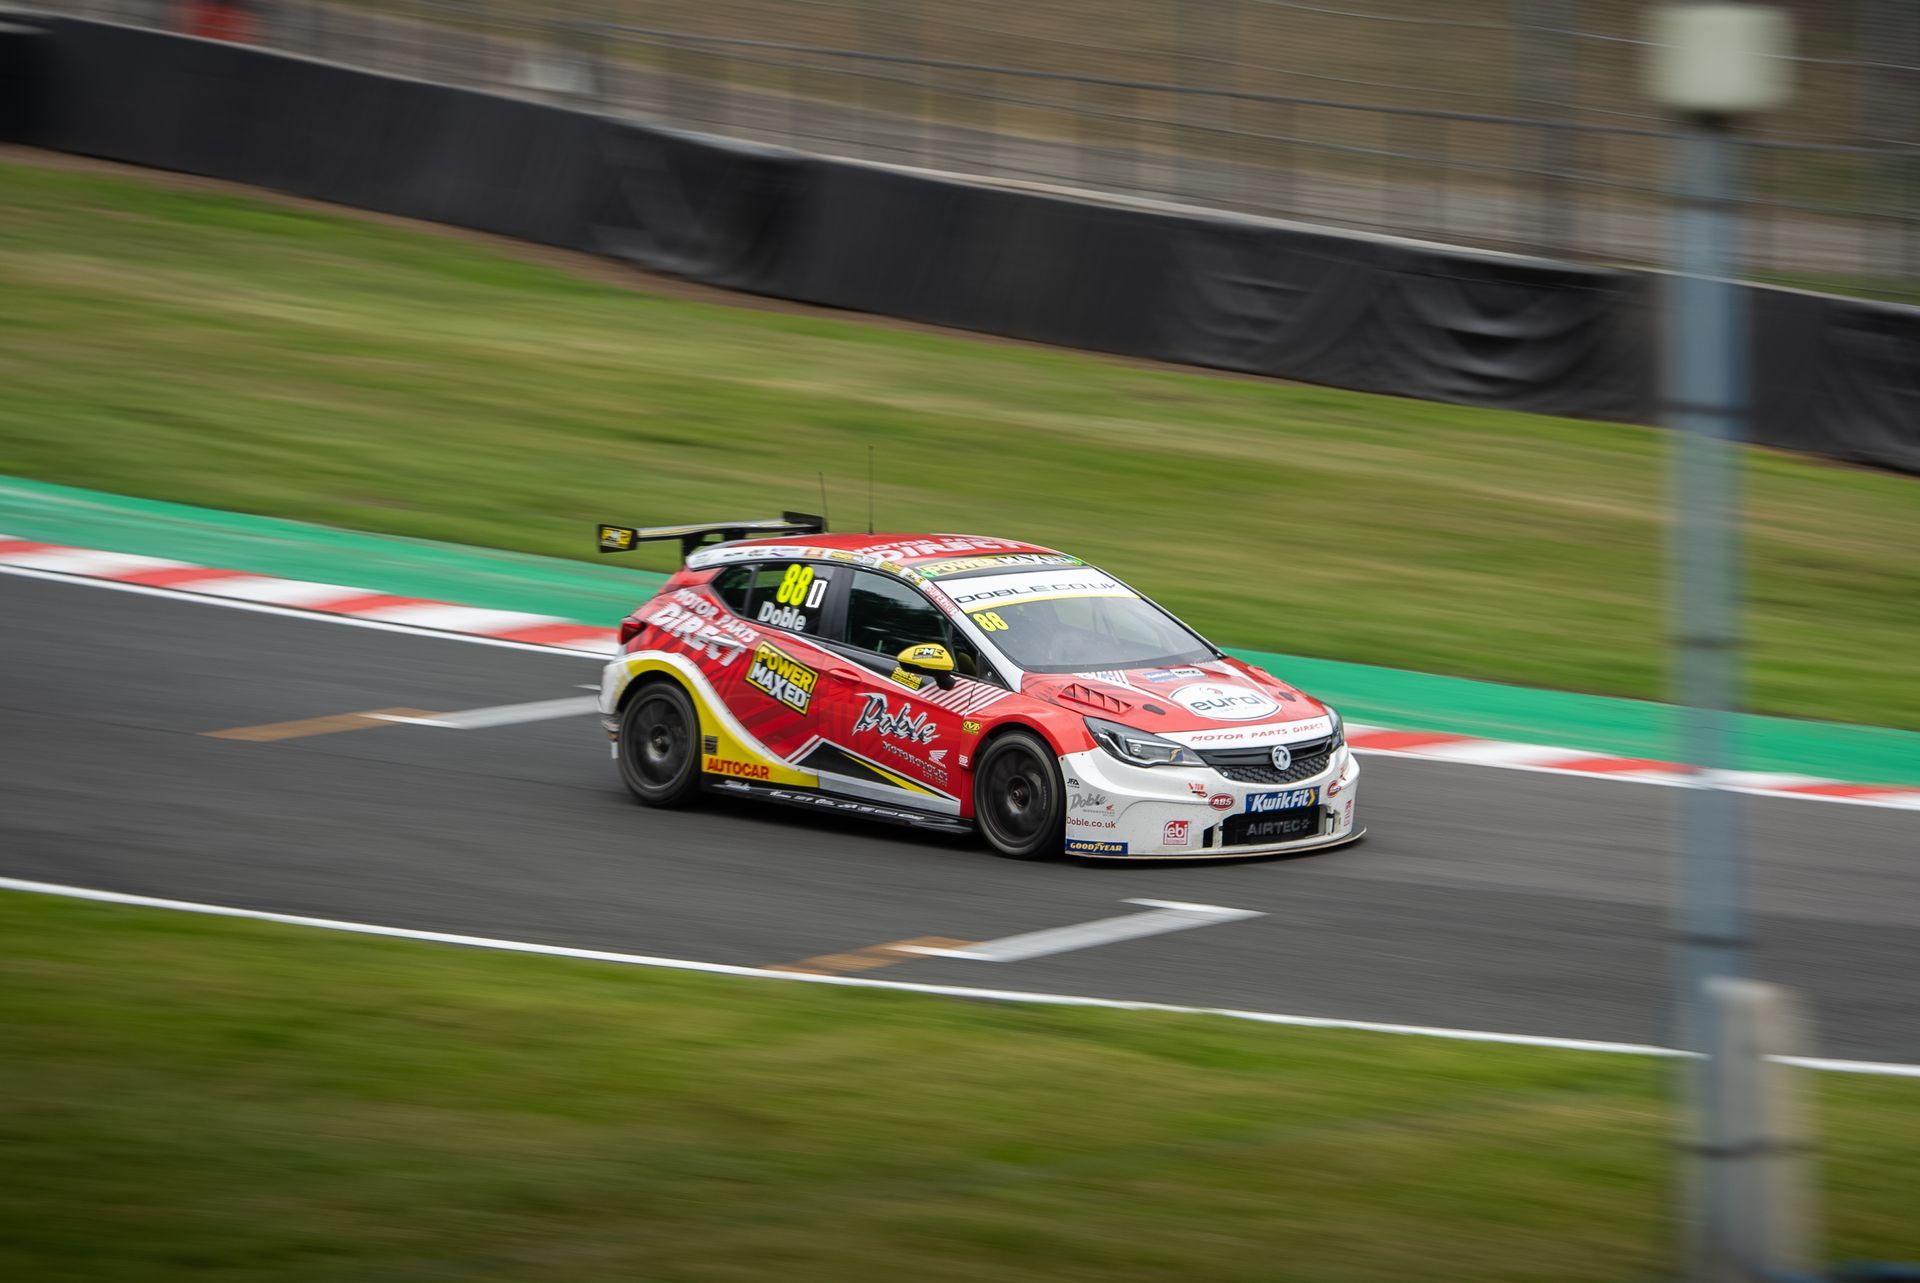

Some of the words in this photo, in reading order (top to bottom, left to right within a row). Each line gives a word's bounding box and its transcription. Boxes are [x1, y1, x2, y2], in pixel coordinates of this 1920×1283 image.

[870, 540, 1021, 562] DIRECT
[776, 564, 814, 606] 88
[672, 588, 719, 620] MOTOR
[715, 613, 760, 643] PARTS
[757, 601, 807, 631] Doble
[972, 611, 1009, 632] 88
[647, 603, 749, 667] DIRECT
[757, 646, 814, 694] POWER
[750, 662, 811, 708] MAXED
[852, 692, 941, 745] Doble
[1190, 733, 1244, 742] MOTOR
[1251, 728, 1288, 739] PARTS
[1293, 722, 1324, 733] DIRECT
[708, 757, 769, 779] AUTOCAR
[1069, 793, 1108, 811] Doble
[1213, 798, 1232, 806] ABS
[1066, 816, 1116, 828] Doble.co.uk
[1246, 820, 1300, 836] AIRTEC
[1070, 842, 1122, 852] GOODYEAR
